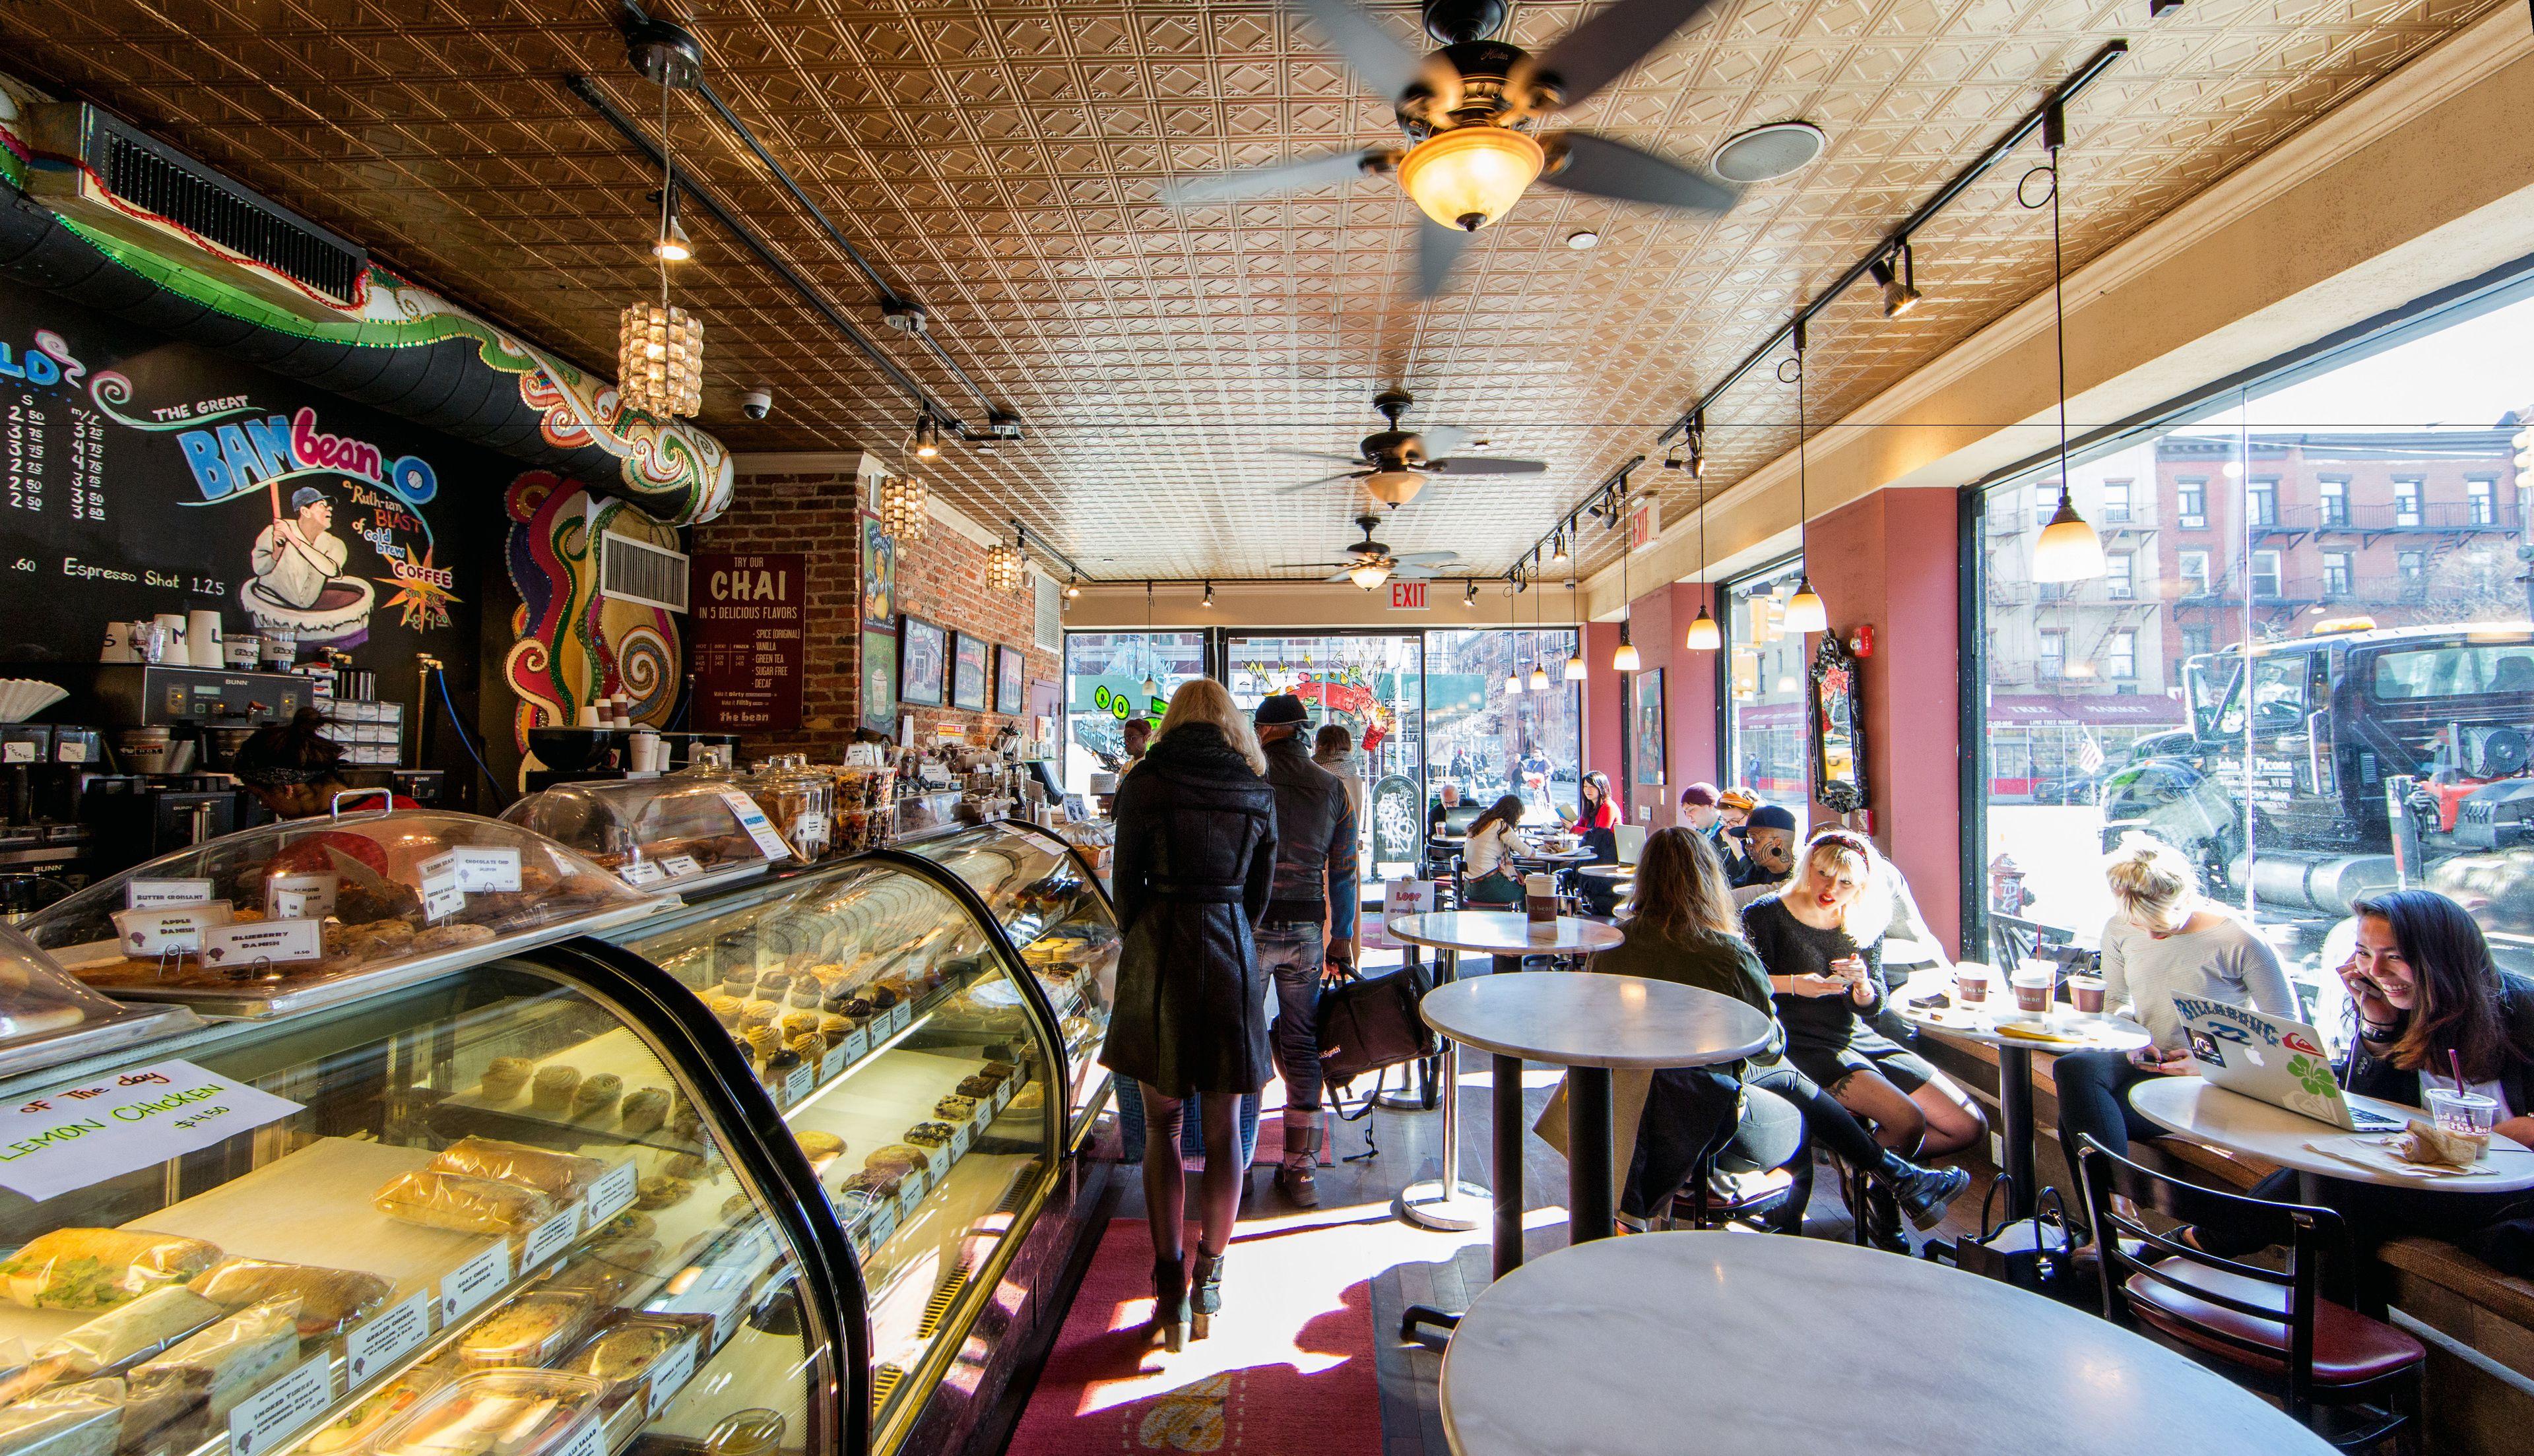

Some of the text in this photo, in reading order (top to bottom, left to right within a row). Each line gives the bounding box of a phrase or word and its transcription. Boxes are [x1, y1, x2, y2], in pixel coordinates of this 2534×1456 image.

[1480, 48, 1509, 60] Hunter
[152, 395, 249, 422] THE GREAT
[350, 485, 404, 513] Ruth-ian
[352, 518, 366, 534] of
[374, 509, 423, 533] BLAST
[1633, 506, 1648, 548] EXIT
[364, 528, 391, 544] cold
[376, 542, 405, 558] brew
[734, 557, 763, 567] TRY OUR
[63, 557, 137, 582] Espresso
[145, 571, 179, 588] Shot
[193, 578, 224, 595] 1.25
[393, 560, 453, 588] COFFEE
[711, 571, 786, 601] CHAI
[1392, 583, 1427, 607] EXIT
[699, 607, 797, 619] IN 5 DELICIOUS FLAVORS
[104, 634, 116, 647] S
[172, 628, 187, 645] M
[211, 628, 223, 645] L
[756, 629, 800, 640] SPICE (ORIGINAL)
[756, 642, 776, 651] VANILLA
[756, 654, 773, 664] GREEN
[775, 654, 784, 663] TEA
[756, 666, 788, 676] SUGAR FREE
[755, 679, 772, 688] DECAF
[720, 712, 769, 722] the bean
[2007, 706, 2052, 714] TREE
[2217, 757, 2292, 771] John Picone
[1396, 892, 1421, 901] LOOP
[232, 931, 289, 941] BLUEBERRY
[2172, 997, 2279, 1048] BILLABONG
[58, 1085, 111, 1100] The
[117, 1070, 171, 1087] day
[173, 1106, 230, 1130] $4.50
[2450, 1121, 2472, 1133] the
[0, 1118, 106, 1162] LEMON
[457, 1276, 472, 1288] GOAT
[366, 1309, 414, 1343] GRILLED CHICKEN
[254, 1378, 314, 1420] SMOKED TURKEY
[257, 1424, 271, 1436] AND
[295, 1397, 313, 1412] MAYO
[579, 1428, 597, 1449] SALAD
